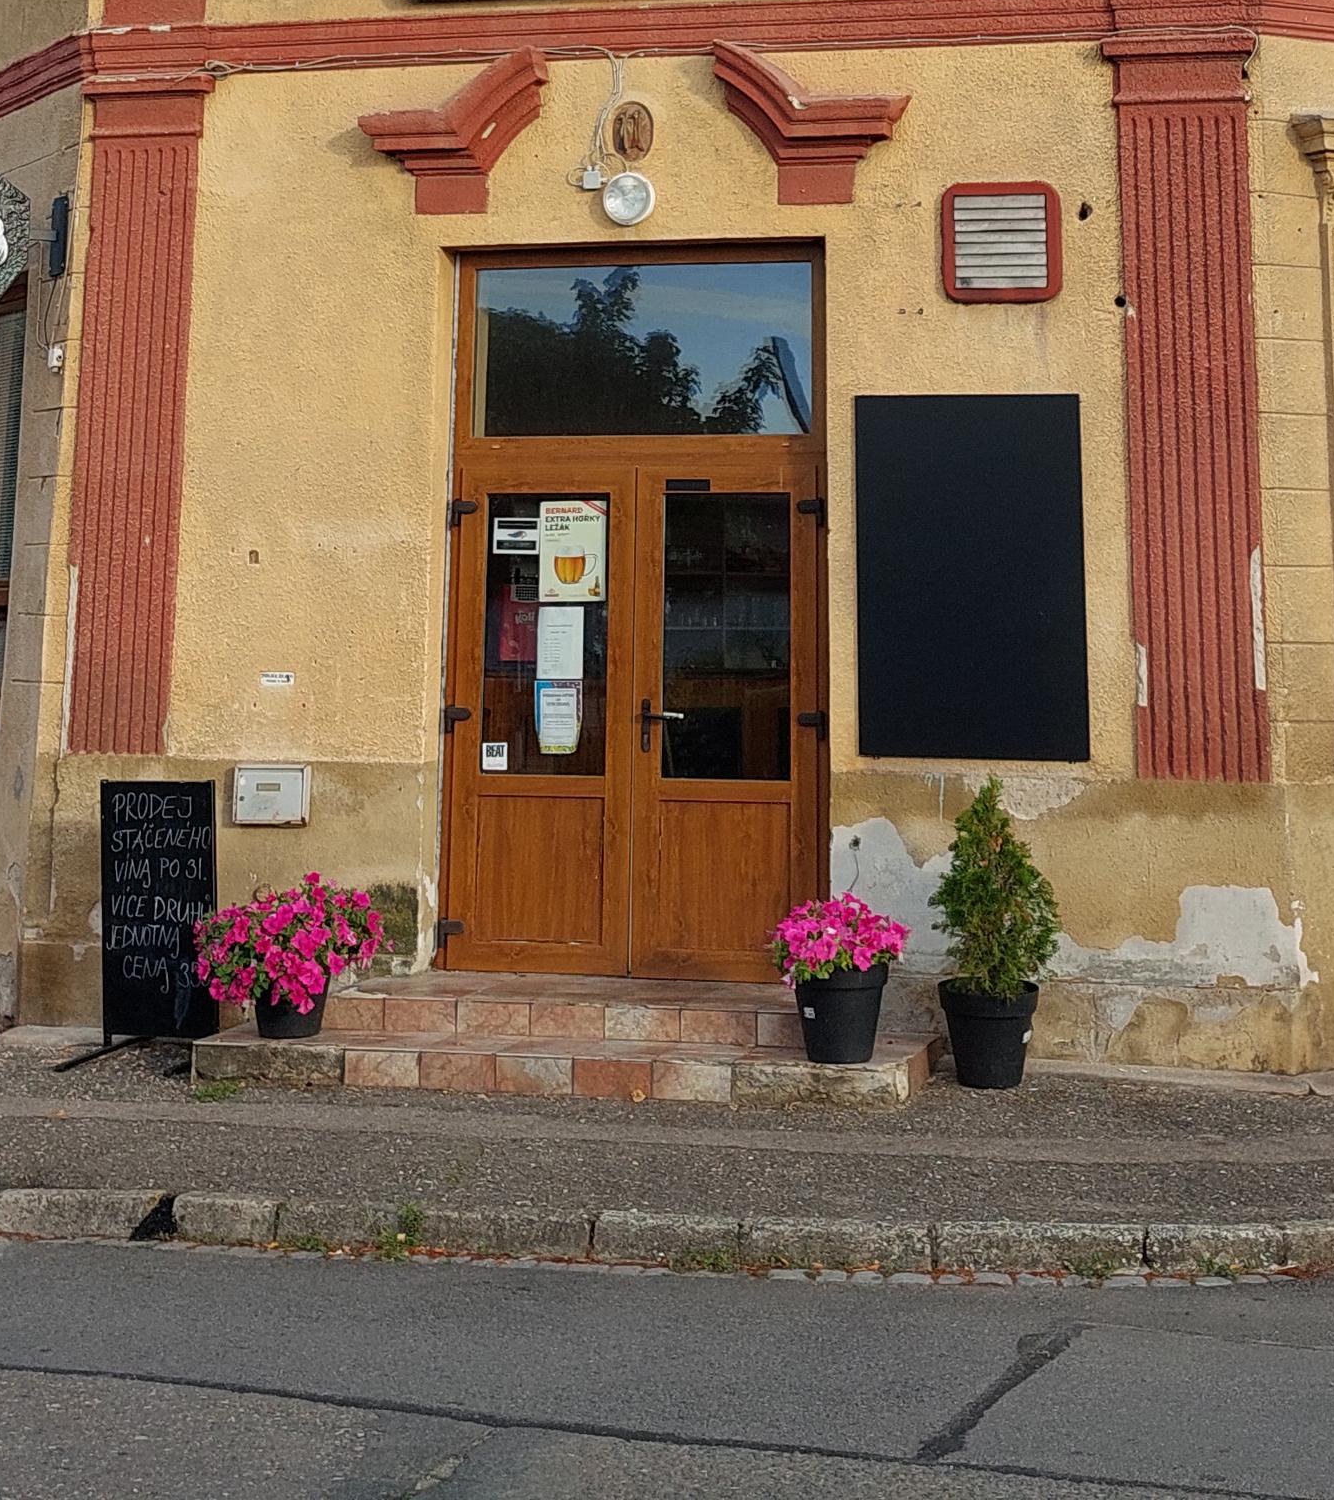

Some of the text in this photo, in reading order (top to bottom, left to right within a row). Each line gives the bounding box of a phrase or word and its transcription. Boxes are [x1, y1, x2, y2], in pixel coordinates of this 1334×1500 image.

[486, 745, 505, 757] BEAT
[112, 792, 192, 823] PRODEJ
[111, 821, 211, 854] STÁČENÉHO
[115, 853, 151, 888] VÍNA
[160, 857, 180, 878] PO
[111, 886, 147, 917] VÍCE
[123, 955, 169, 994] CENA
